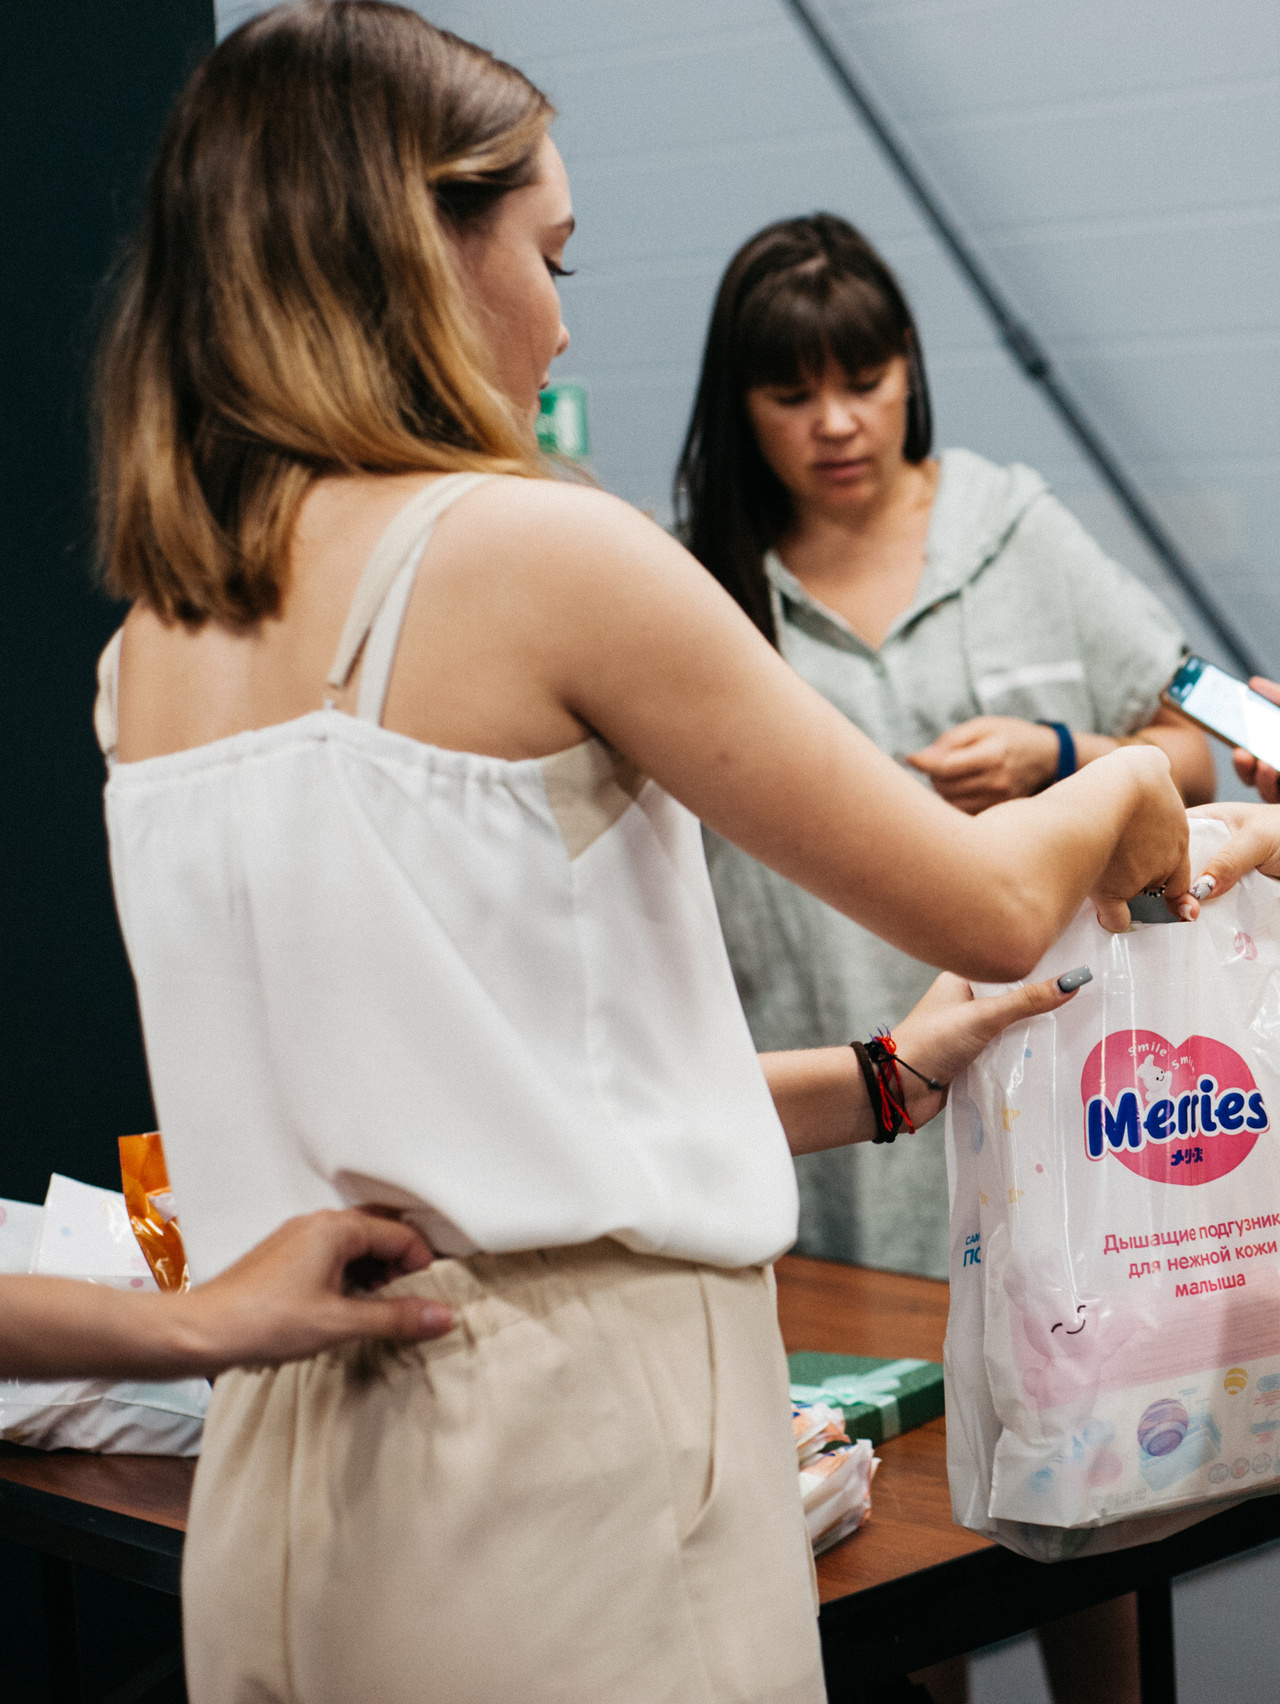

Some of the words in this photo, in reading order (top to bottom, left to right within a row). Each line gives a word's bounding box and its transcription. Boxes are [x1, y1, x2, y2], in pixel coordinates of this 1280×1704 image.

[1103, 1228, 1197, 1255] Дышащие
[1128, 1260, 1161, 1279] для
[1167, 1246, 1231, 1271] нежной
[1235, 1240, 1278, 1260] кожи
[1174, 1273, 1246, 1297] малыша
